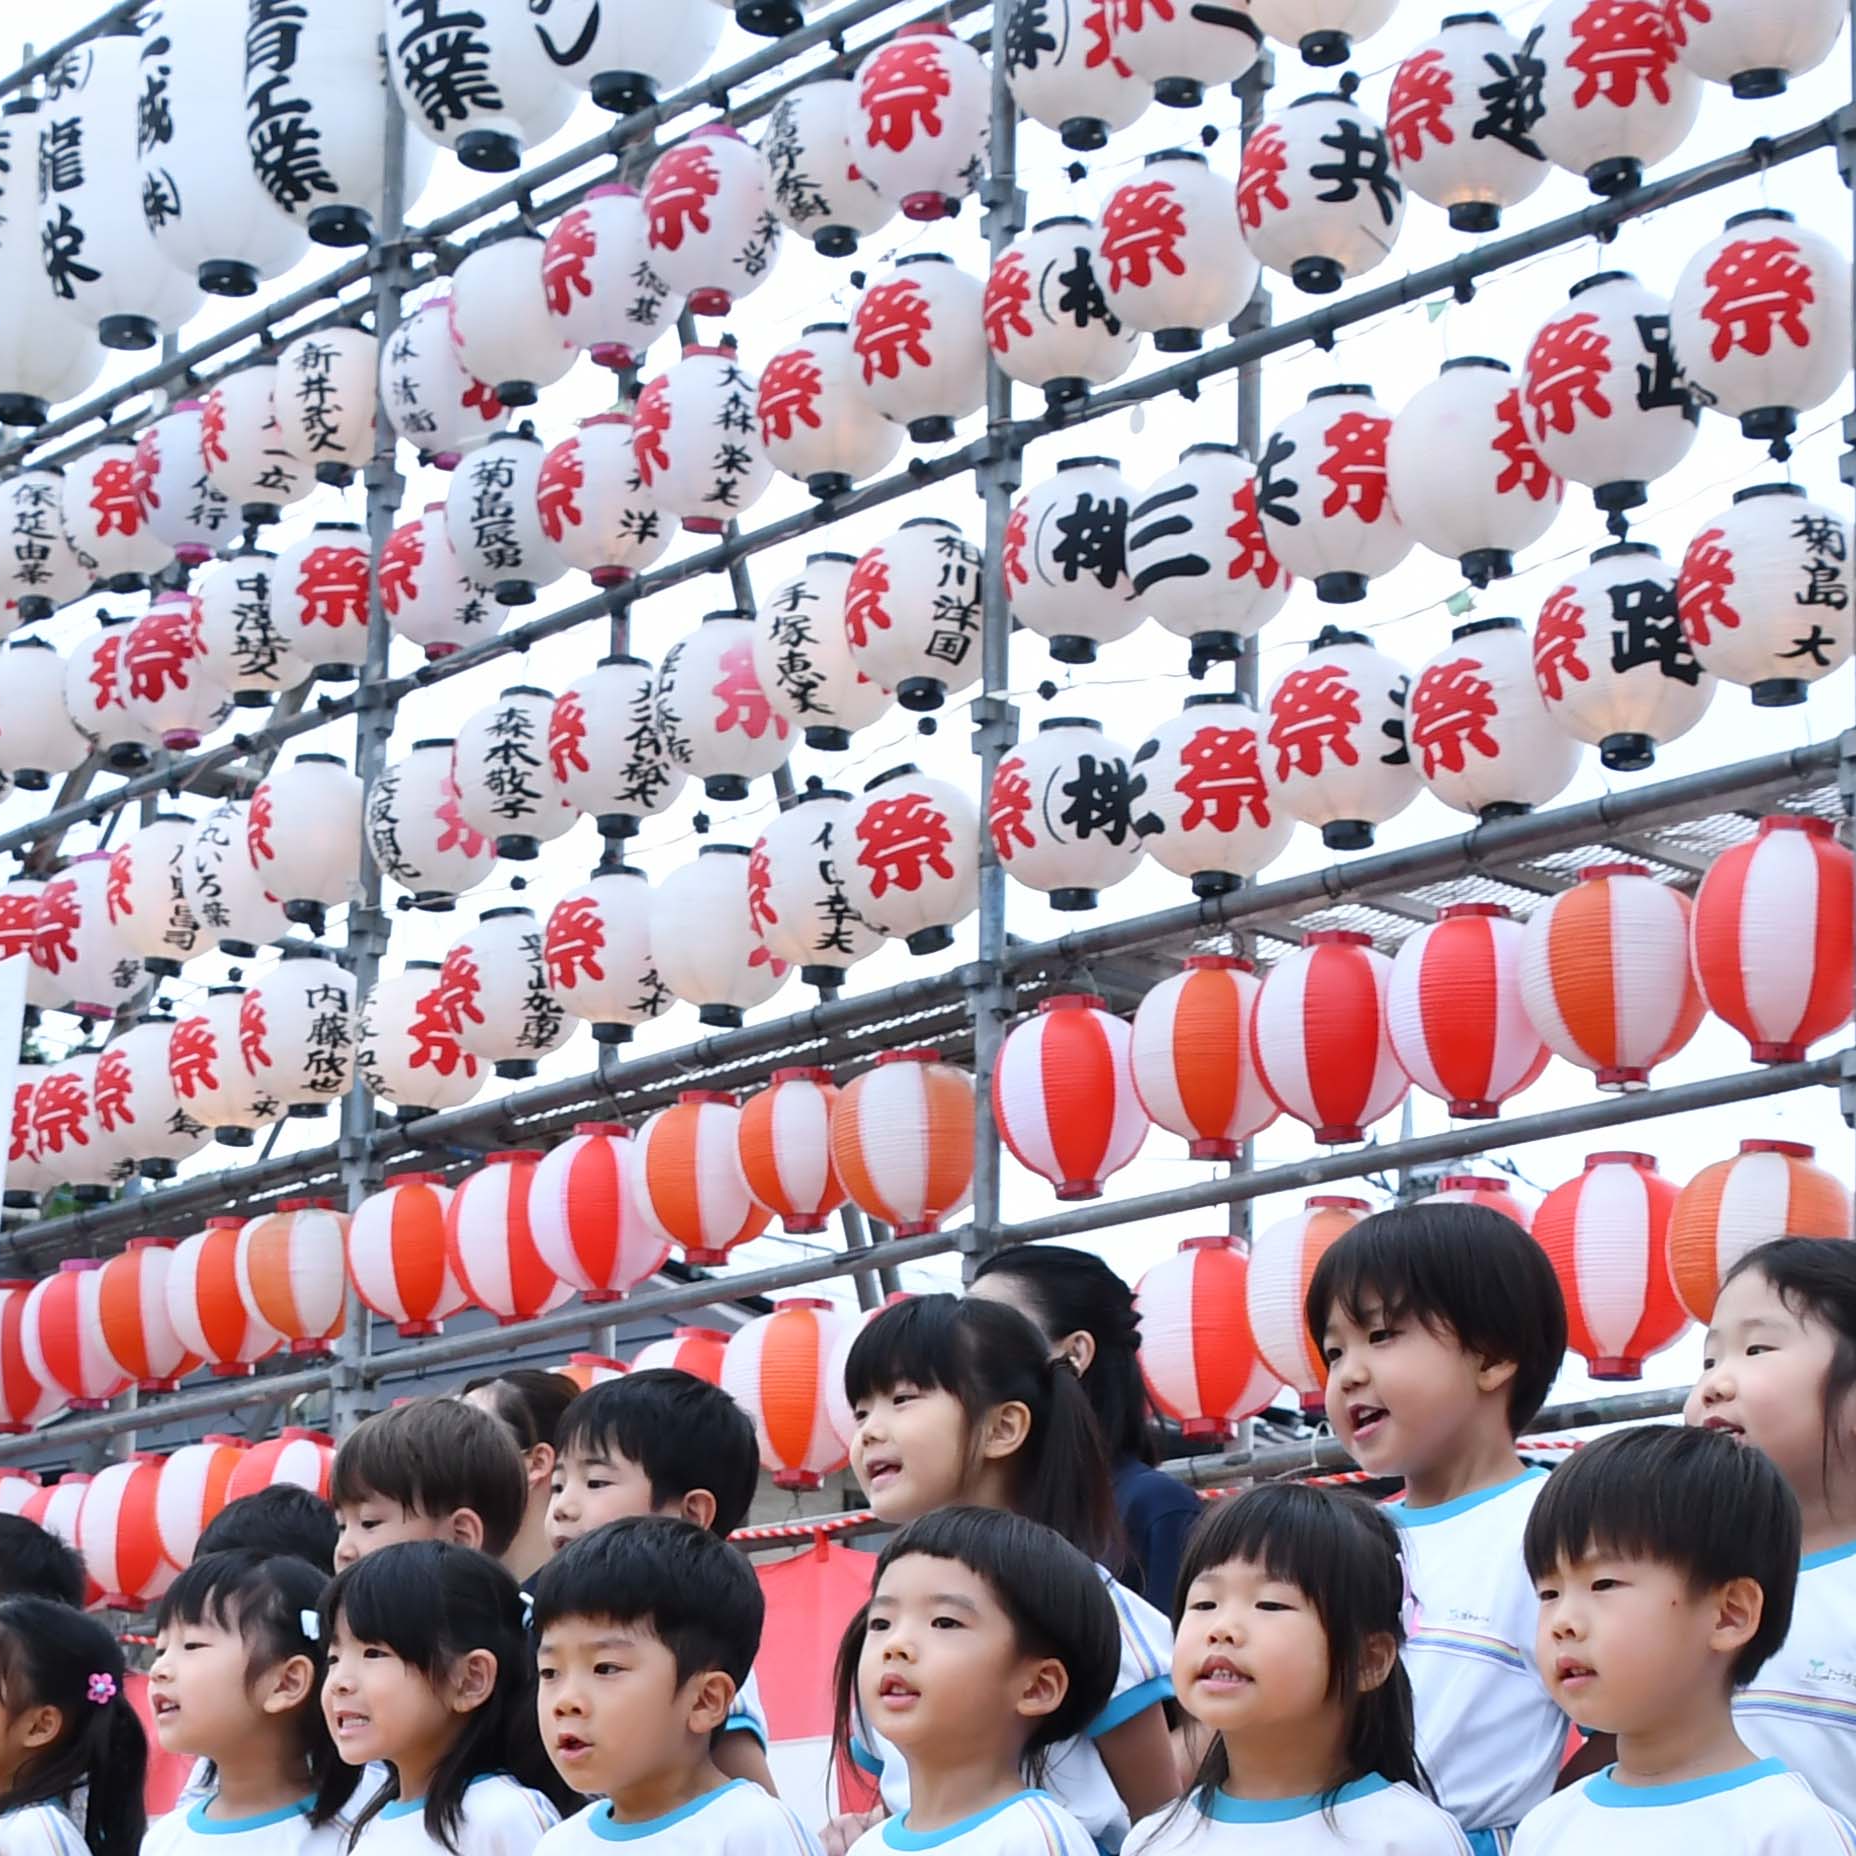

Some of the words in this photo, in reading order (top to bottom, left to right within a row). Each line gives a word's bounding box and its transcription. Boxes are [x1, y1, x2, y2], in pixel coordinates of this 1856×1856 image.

[861, 42, 951, 153] 祭
[1566, 0, 1677, 108] 祭
[1386, 51, 1454, 168] 祭
[646, 147, 719, 251] 祭
[1237, 126, 1289, 232] 祭
[544, 211, 595, 315] 祭
[1101, 182, 1187, 293] 祭
[854, 280, 932, 384] 祭
[1701, 238, 1815, 362] 祭
[757, 350, 822, 445] 祭
[1525, 313, 1612, 442] 祭
[296, 547, 371, 628] 祭
[1677, 529, 1741, 646] 祭
[125, 614, 188, 701] 祭
[1534, 587, 1590, 701] 祭
[484, 707, 542, 819] 森本敬子
[1268, 666, 1362, 782] 祭
[1412, 659, 1500, 780] 祭
[1175, 727, 1272, 833] 祭
[856, 794, 955, 899] 祭
[544, 897, 605, 989] 祭
[170, 1017, 219, 1098] 祭
[35, 1073, 89, 1152] 祭
